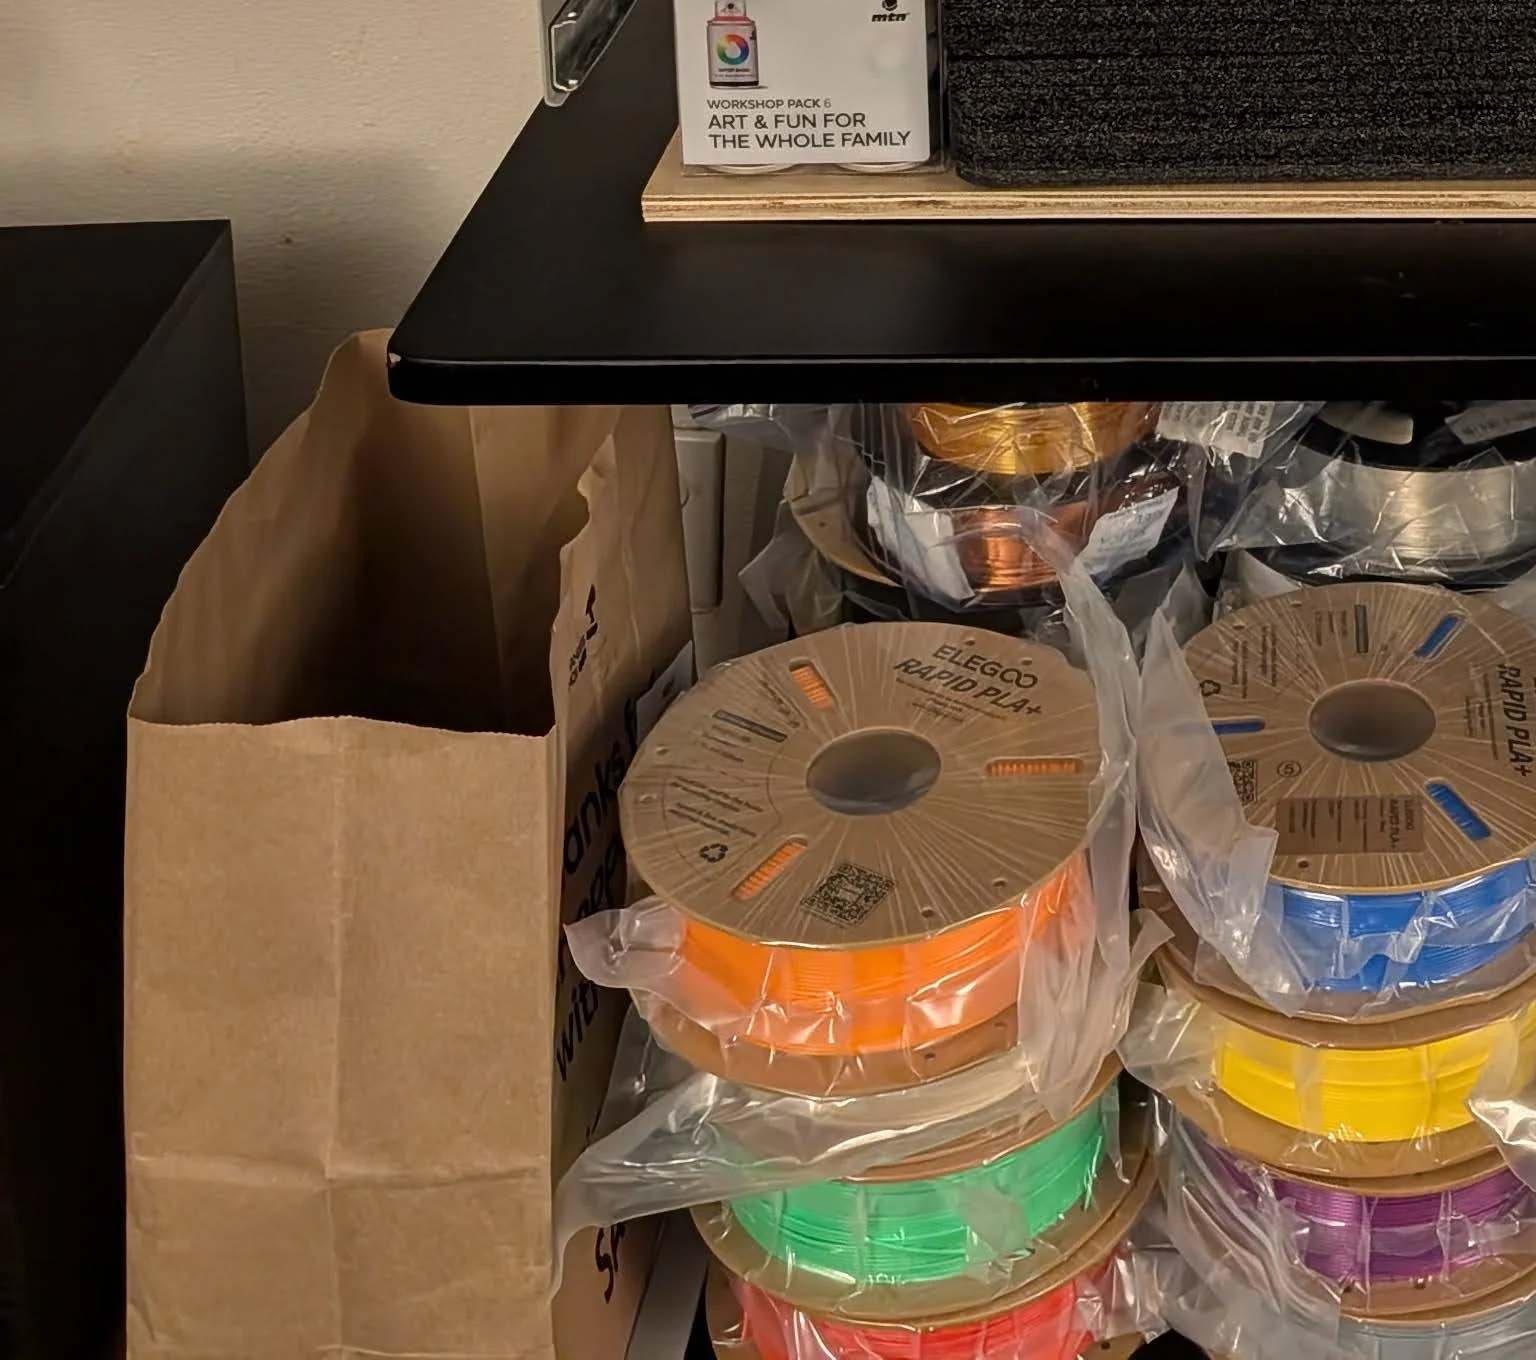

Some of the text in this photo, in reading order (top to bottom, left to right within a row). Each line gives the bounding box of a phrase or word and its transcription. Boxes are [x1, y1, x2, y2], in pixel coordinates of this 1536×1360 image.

[706, 98, 785, 110] WORKSHOP
[787, 98, 821, 109] PACK
[708, 112, 867, 130] ART & FUN FOR
[708, 131, 912, 149] THE WHOLE FAMILY
[932, 643, 1038, 689] ELEGOO
[892, 658, 978, 693] RAPID
[973, 686, 1043, 715] PLA+
[1496, 664, 1534, 777] RAPID PLA+
